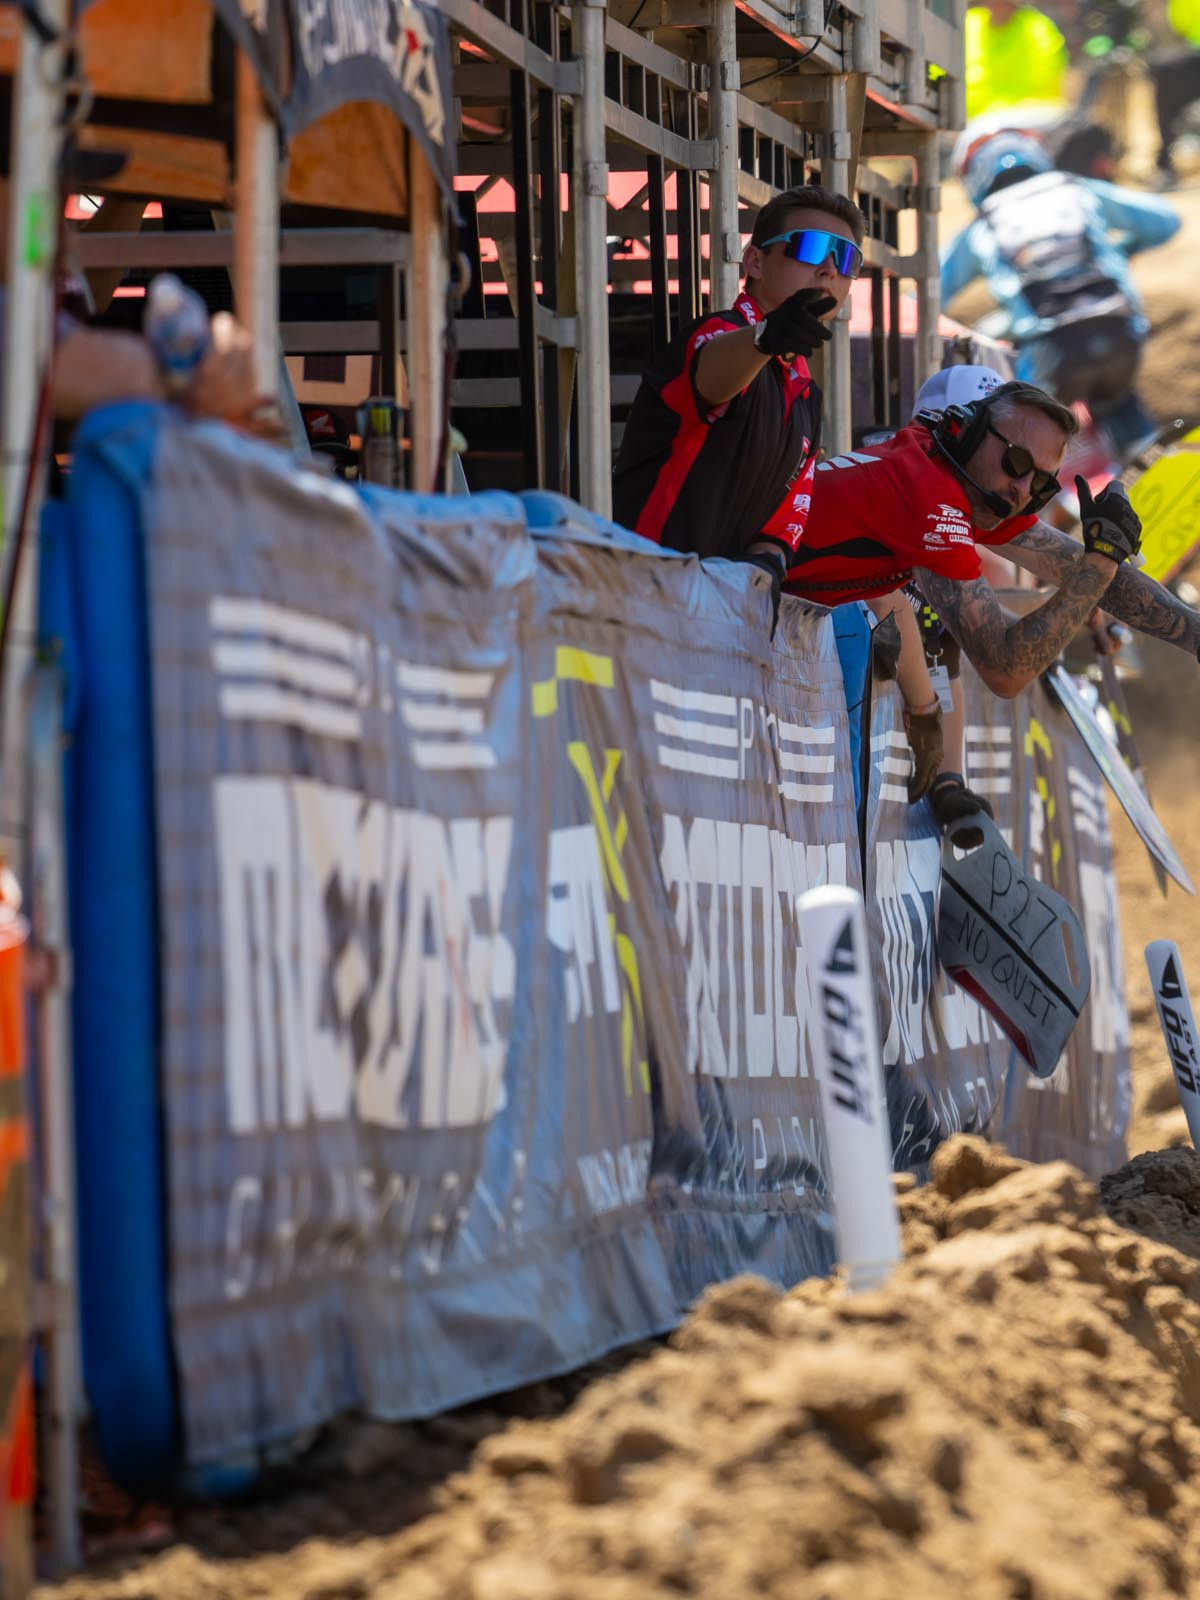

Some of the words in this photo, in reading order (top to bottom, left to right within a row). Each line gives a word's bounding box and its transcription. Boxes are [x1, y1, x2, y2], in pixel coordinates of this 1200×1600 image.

[935, 523, 969, 536] SHOWA
[957, 911, 989, 964] NO
[991, 953, 1058, 1026] QUIT
[1160, 1002, 1197, 1094] UFO
